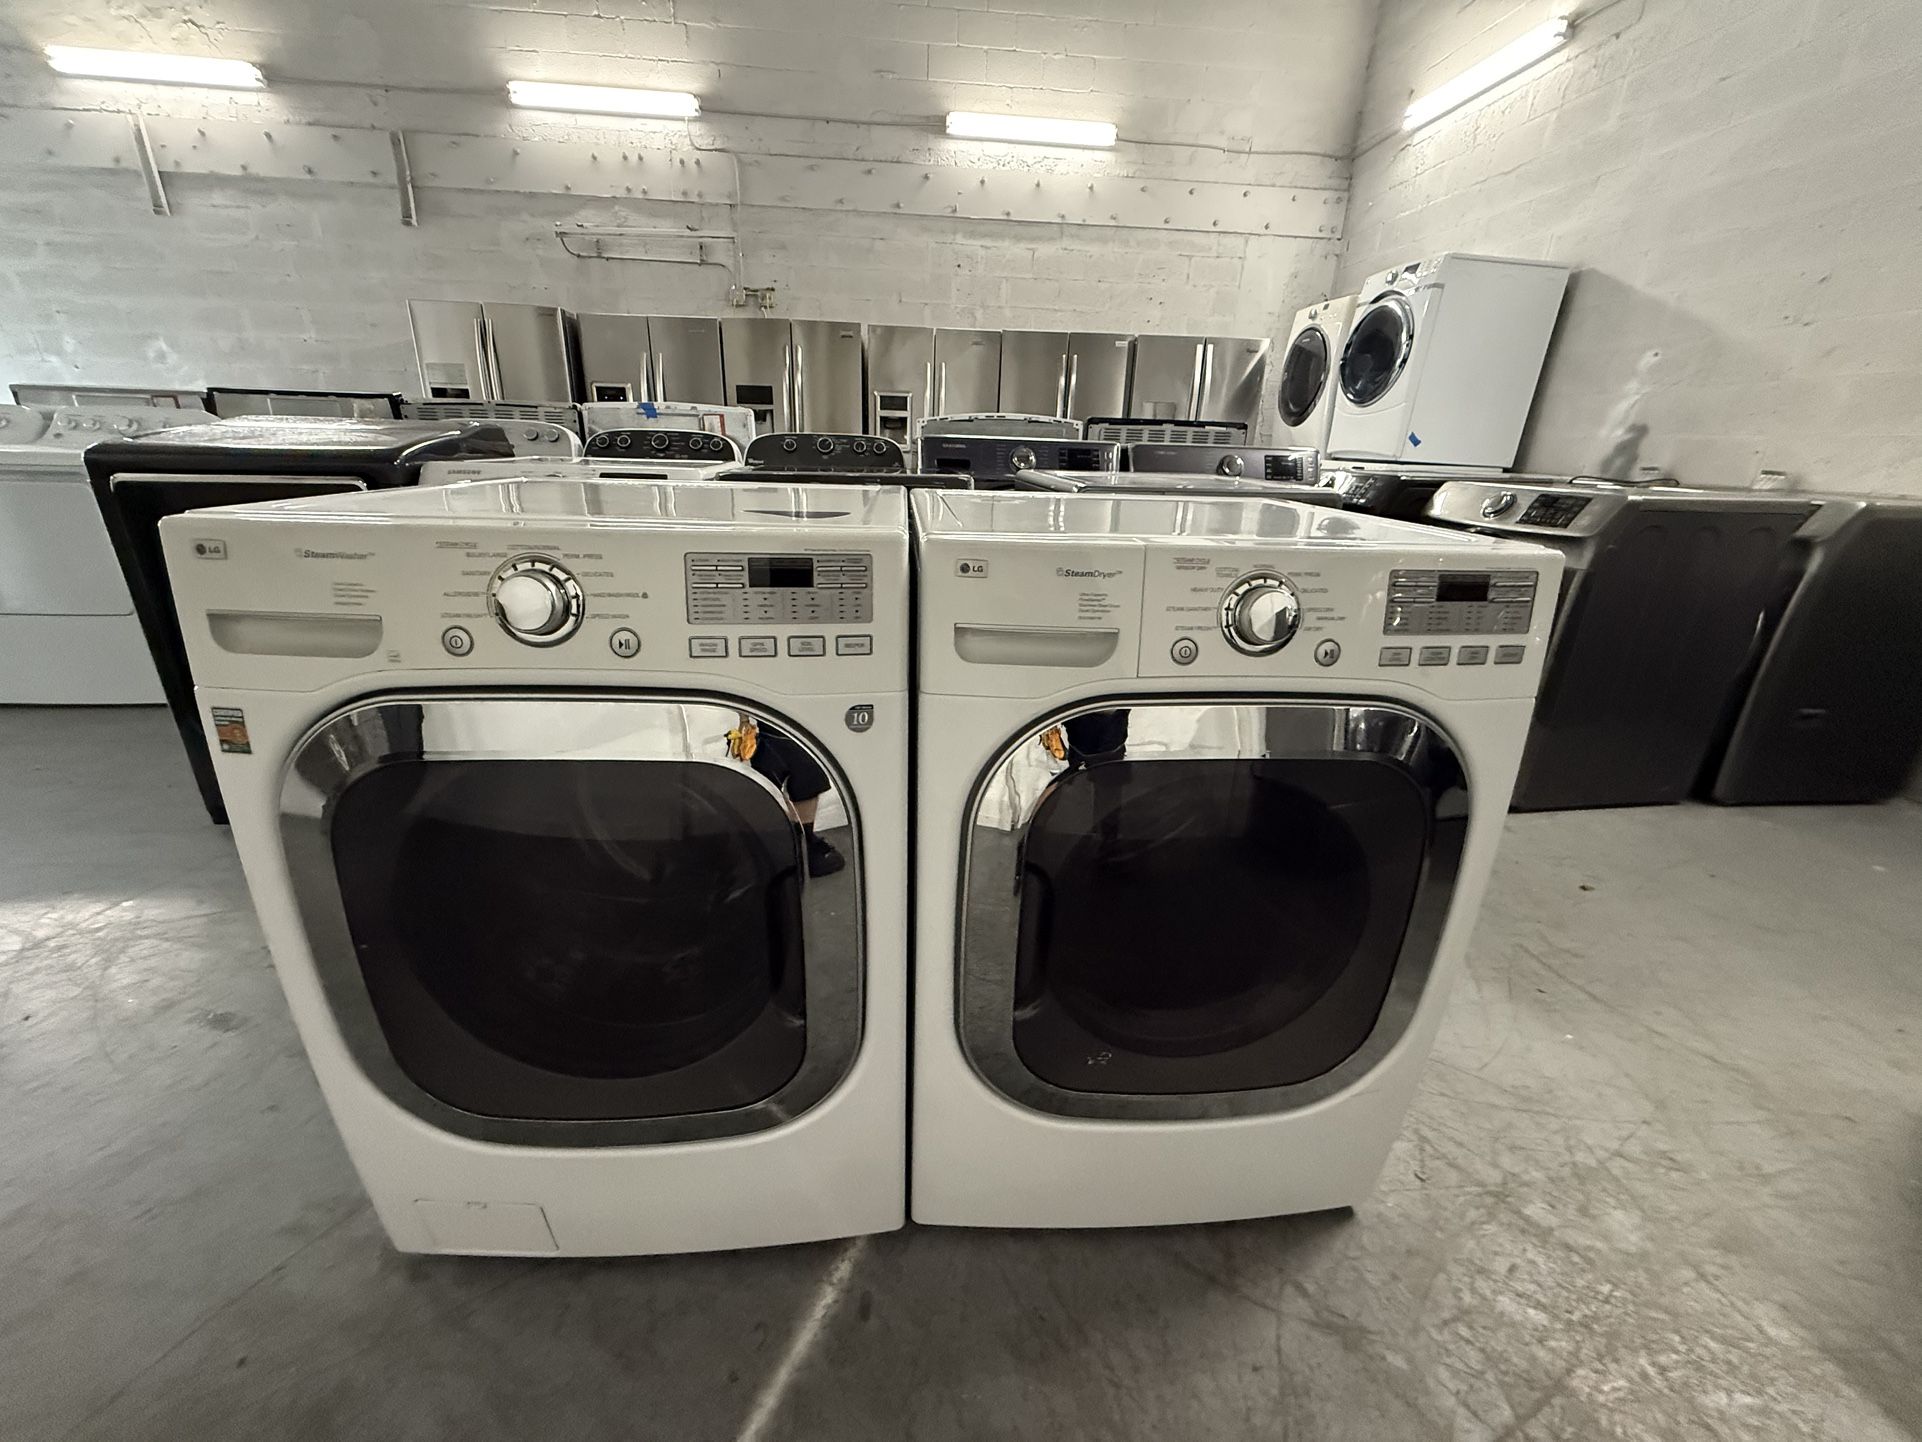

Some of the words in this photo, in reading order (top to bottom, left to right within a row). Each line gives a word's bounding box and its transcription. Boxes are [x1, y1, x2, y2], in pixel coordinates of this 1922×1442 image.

[208, 546, 221, 554] LG
[972, 565, 984, 573] LG
[852, 711, 868, 725] 10
